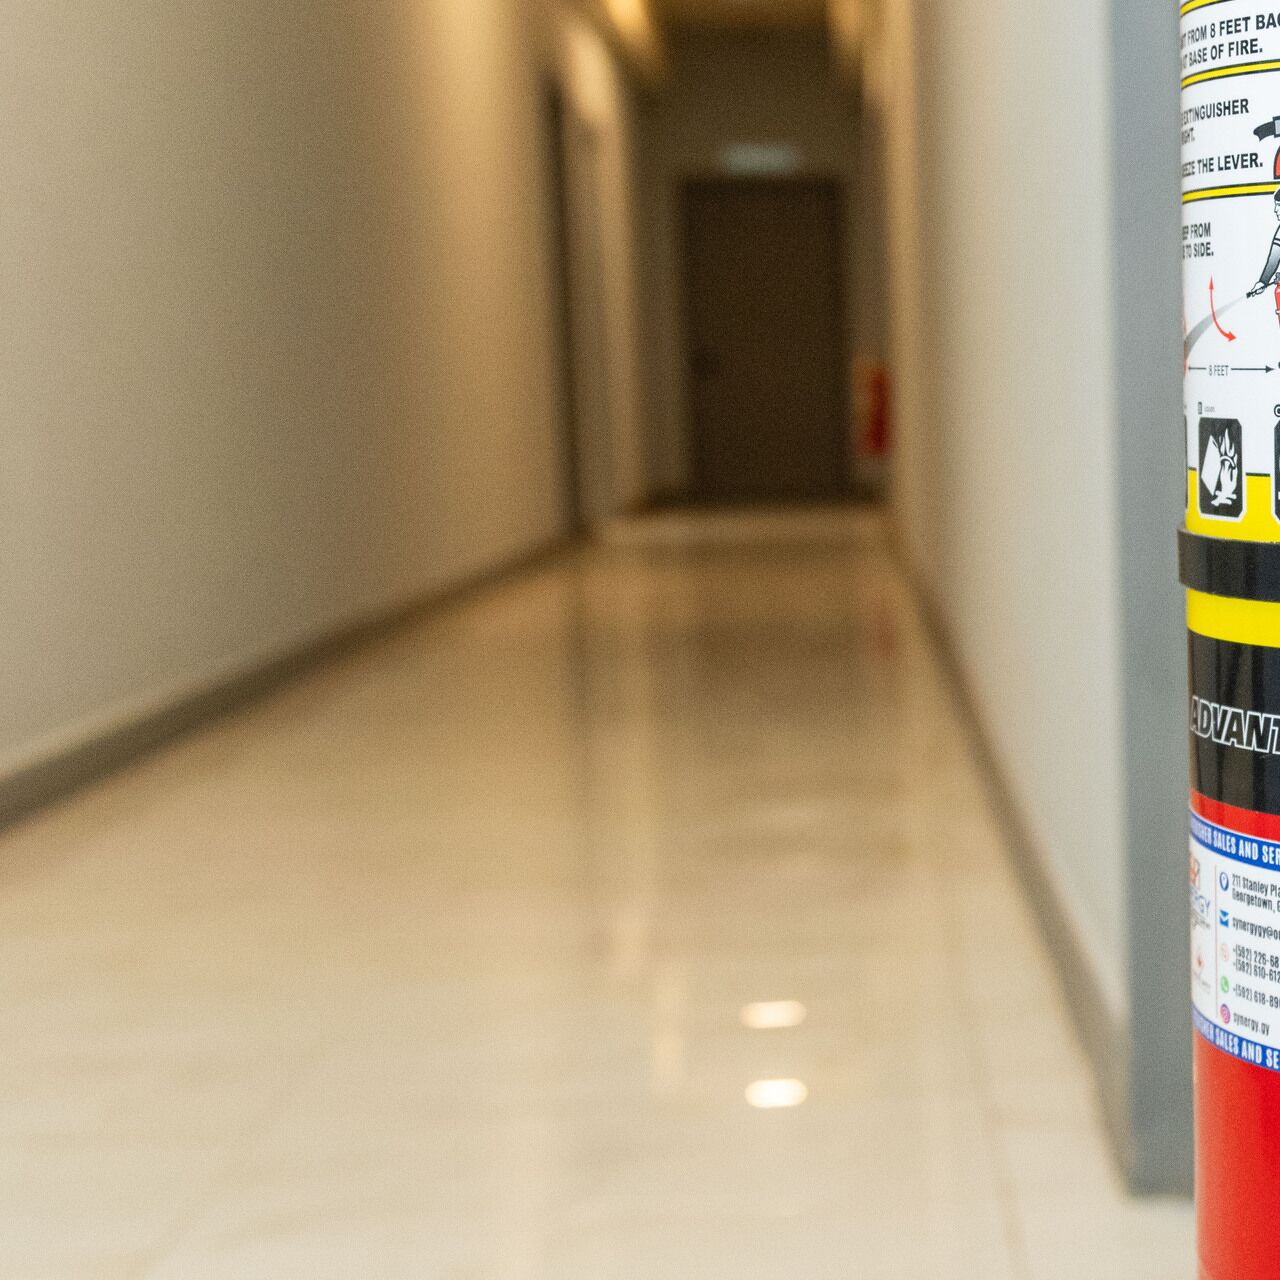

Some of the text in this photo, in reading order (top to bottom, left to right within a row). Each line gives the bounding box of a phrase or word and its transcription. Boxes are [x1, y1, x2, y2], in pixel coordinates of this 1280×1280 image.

[1187, 24, 1207, 45] FROM
[1209, 23, 1216, 39] 8
[1219, 16, 1251, 37] FEET
[1189, 47, 1208, 67] BASE
[1210, 43, 1225, 61] OF
[1228, 38, 1263, 58] FIRE.
[1197, 157, 1215, 175] THE
[1217, 152, 1264, 172] LEVER.
[1190, 222, 1211, 240] FROM
[1193, 241, 1214, 258] SIDE.
[1214, 364, 1229, 377] FEET
[1212, 829, 1237, 855] SALES
[1238, 838, 1259, 861] AND
[1242, 876, 1269, 896] Stanley
[1231, 887, 1276, 914] Georgetown,
[1233, 1011, 1270, 1037] synergy.gy
[1214, 1025, 1239, 1055] SALES
[1241, 1040, 1262, 1065] AND
